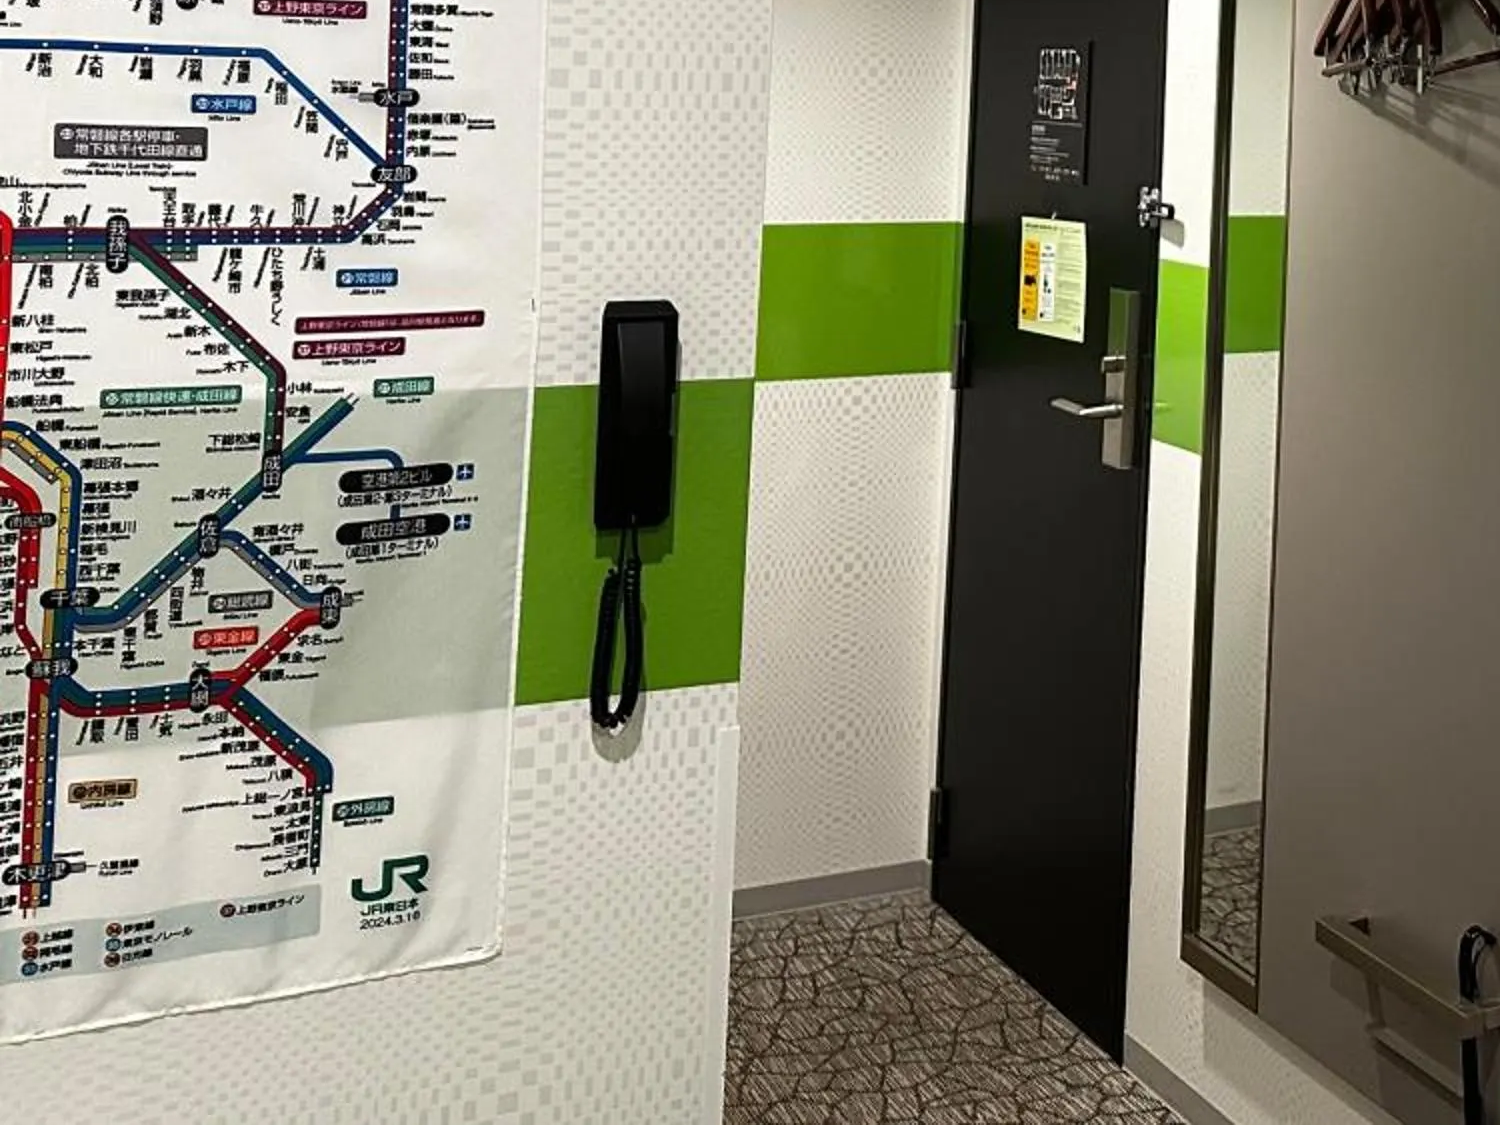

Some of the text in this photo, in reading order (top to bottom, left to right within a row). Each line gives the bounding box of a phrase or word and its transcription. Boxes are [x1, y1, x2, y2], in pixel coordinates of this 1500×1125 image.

[272, 3, 364, 17] 上野東京ライン
[379, 90, 413, 105] 水戸
[377, 166, 412, 182] 友部
[311, 341, 401, 356] 上野東京ライン
[7, 366, 65, 381] 市川大野
[222, 360, 250, 374] 木下
[287, 382, 312, 395] 小林
[50, 590, 91, 606] 千葉
[213, 629, 256, 645] 東金線
[352, 854, 429, 901] JR
[237, 895, 305, 916] 上野東京ライン
